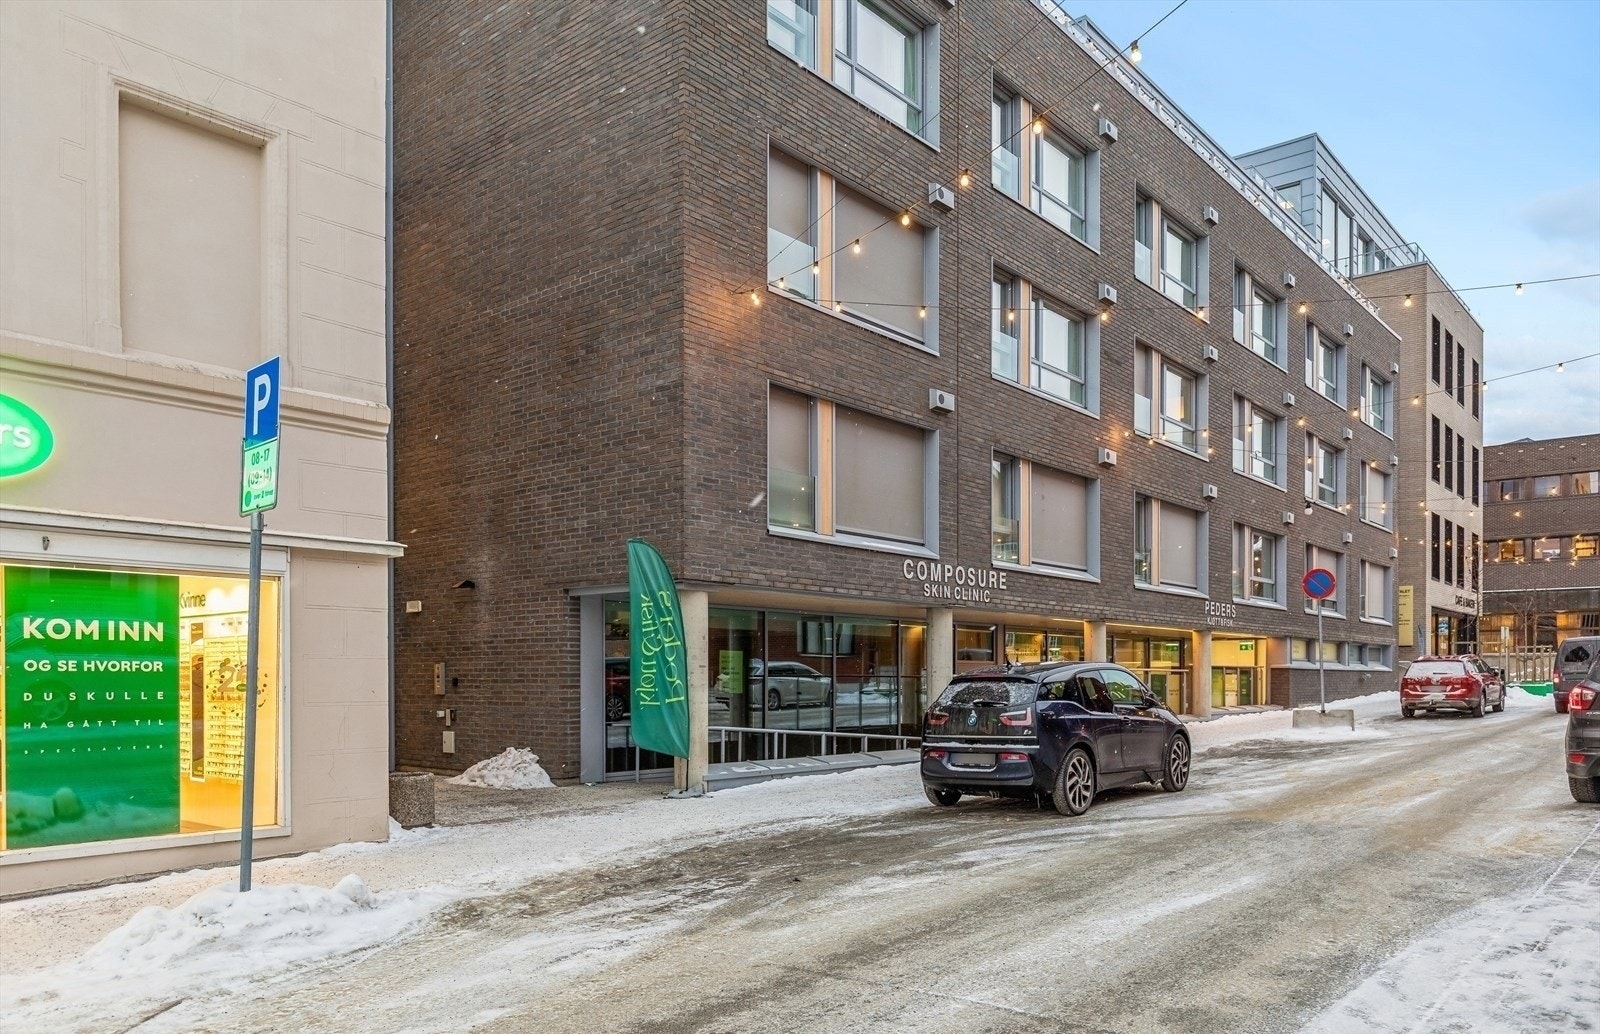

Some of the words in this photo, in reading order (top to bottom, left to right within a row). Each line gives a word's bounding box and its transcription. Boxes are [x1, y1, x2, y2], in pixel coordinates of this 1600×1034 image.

[252, 373, 271, 436] P
[252, 448, 270, 465] 08-17
[903, 559, 1007, 590] COMPOSURE
[923, 583, 951, 599] SKIN
[954, 586, 991, 603] CLINIC
[1205, 600, 1237, 618] PEDERS
[23, 617, 100, 641] KOM
[108, 620, 164, 642] INN
[23, 659, 52, 672] OG
[57, 660, 78, 672] SE
[83, 660, 164, 672] HVORFOR
[23, 692, 53, 702] DU
[69, 691, 164, 701] SKULLE
[23, 721, 48, 730] HA
[67, 719, 117, 728] GÅTT
[134, 719, 164, 727] TIL
